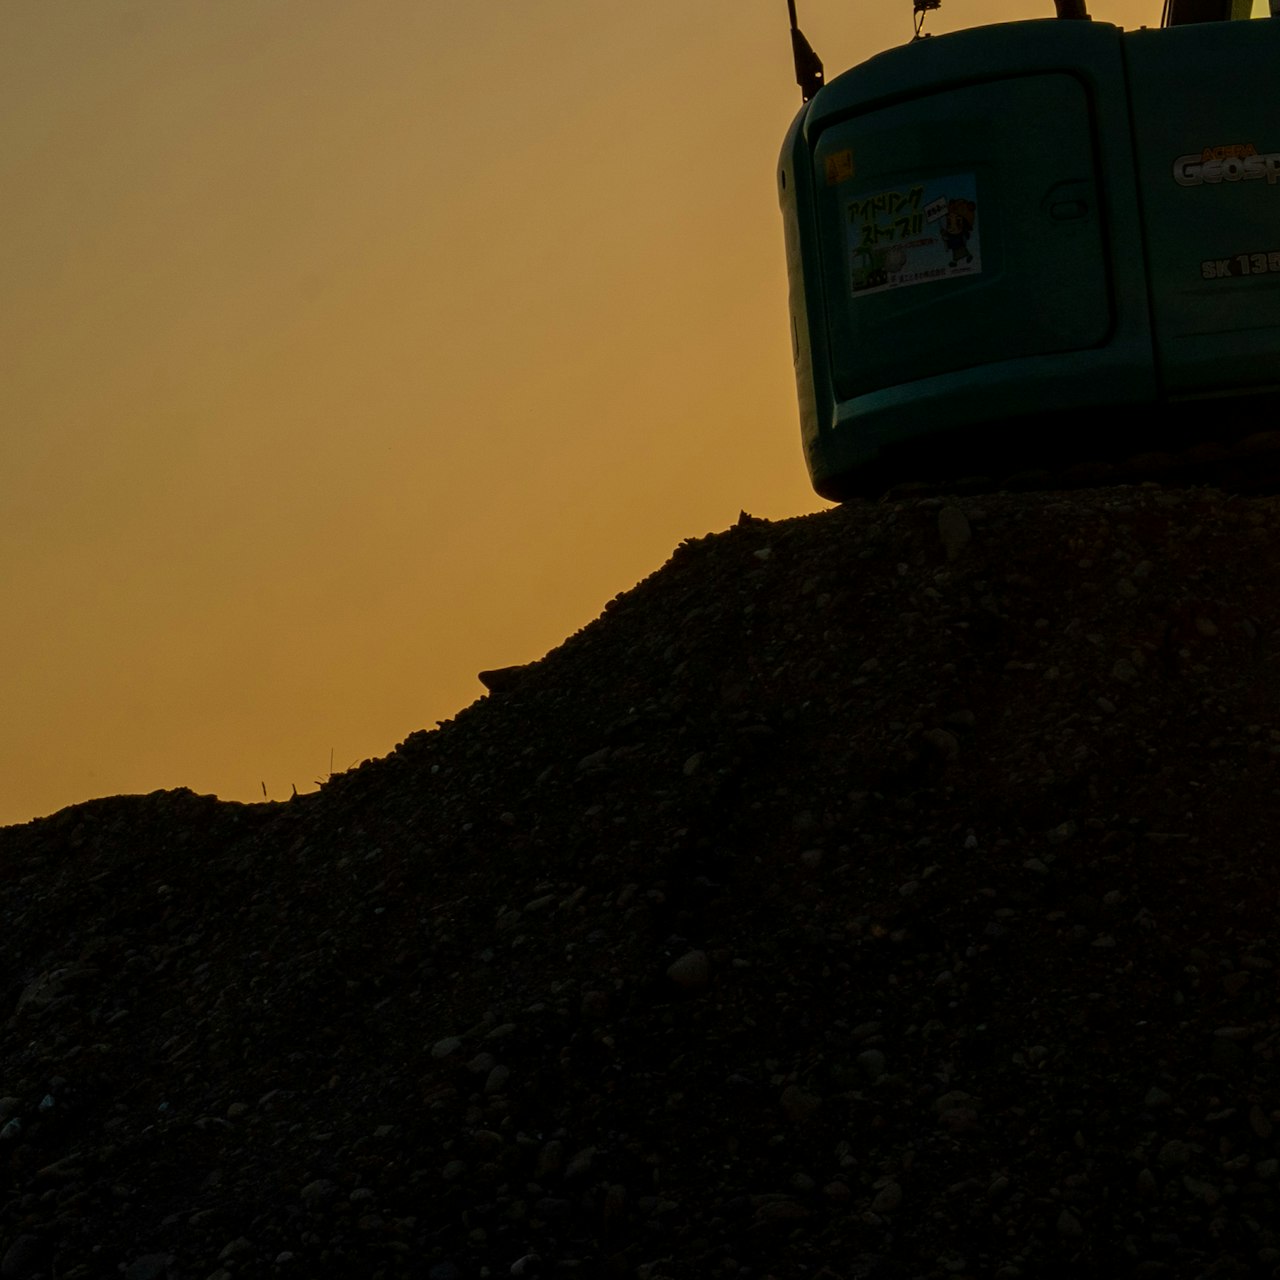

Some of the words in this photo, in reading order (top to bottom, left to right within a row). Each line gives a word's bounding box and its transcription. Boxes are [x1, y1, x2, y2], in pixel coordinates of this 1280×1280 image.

[847, 186, 924, 223] アイドリング
